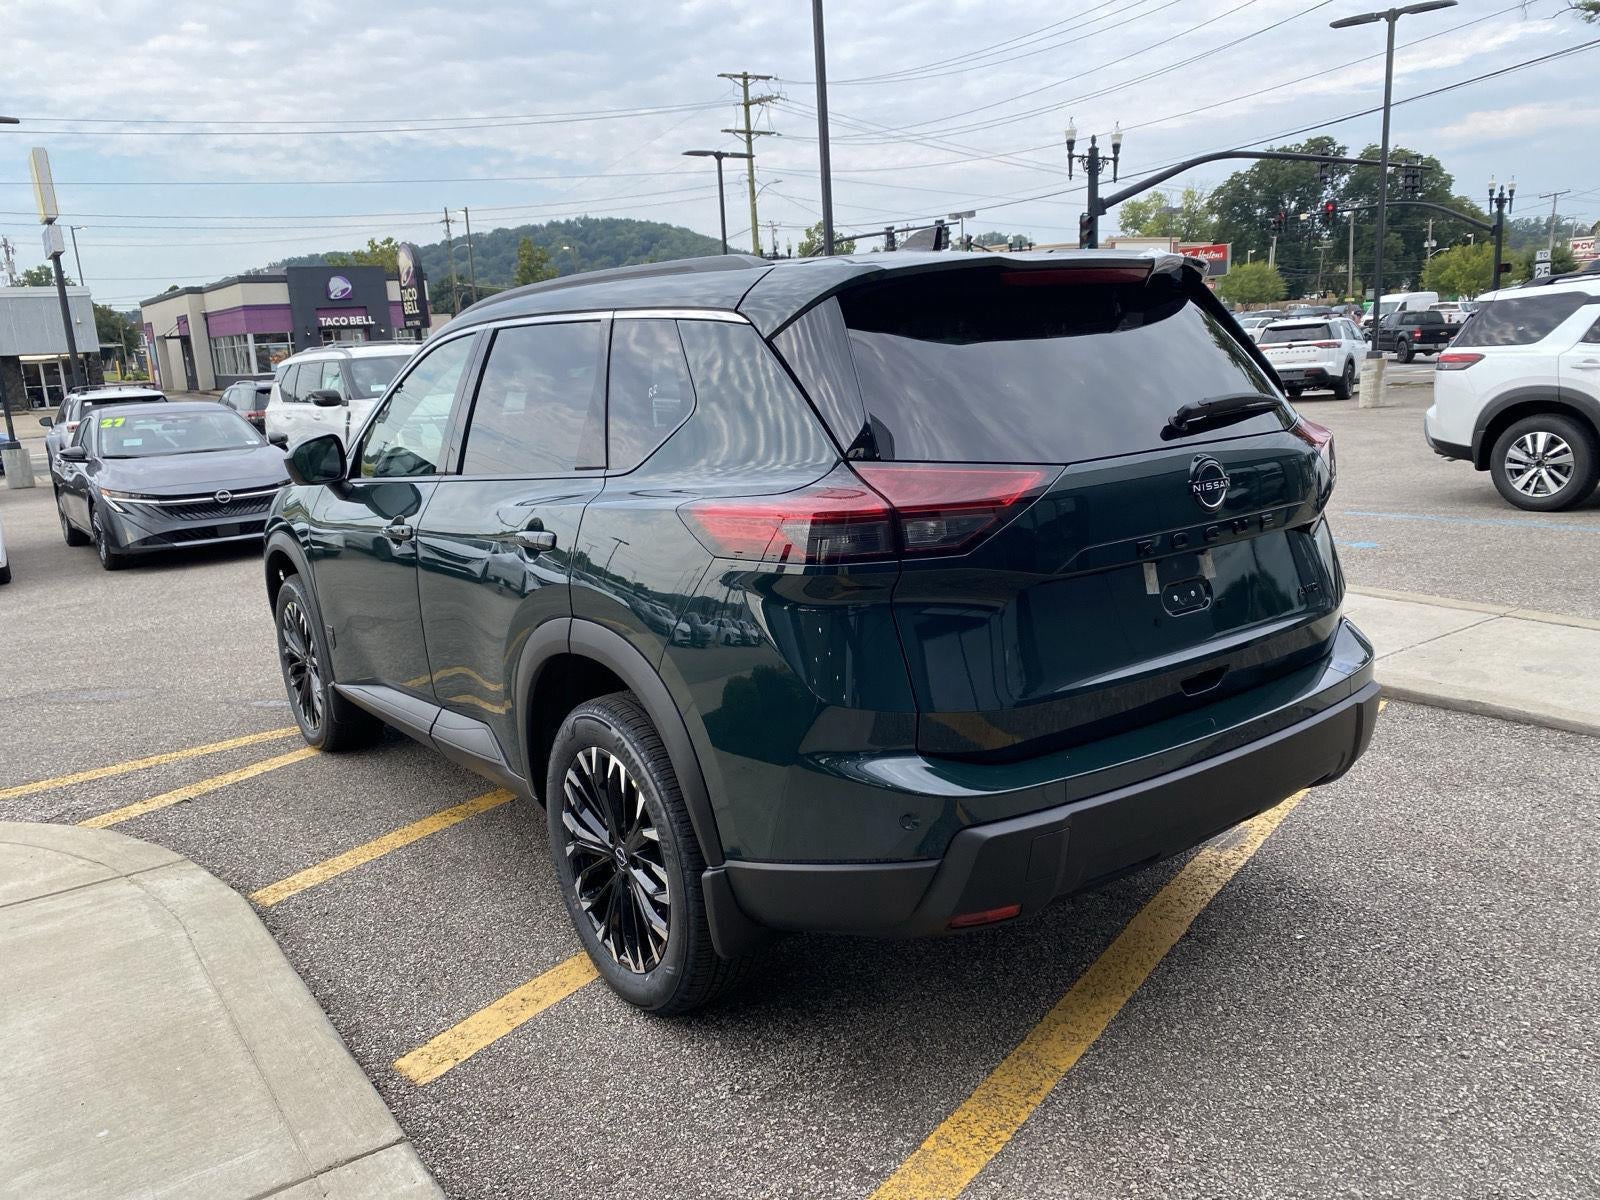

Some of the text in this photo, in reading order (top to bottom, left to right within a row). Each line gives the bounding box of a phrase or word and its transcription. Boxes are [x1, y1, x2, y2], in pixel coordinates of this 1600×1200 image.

[1197, 249, 1223, 259] Hortons
[1536, 267, 1549, 278] 25
[401, 287, 417, 302] TACO
[403, 301, 420, 315] BELL
[320, 315, 375, 326] TACO BELL
[101, 416, 125, 429] 27
[1193, 478, 1230, 492] NISSAN
